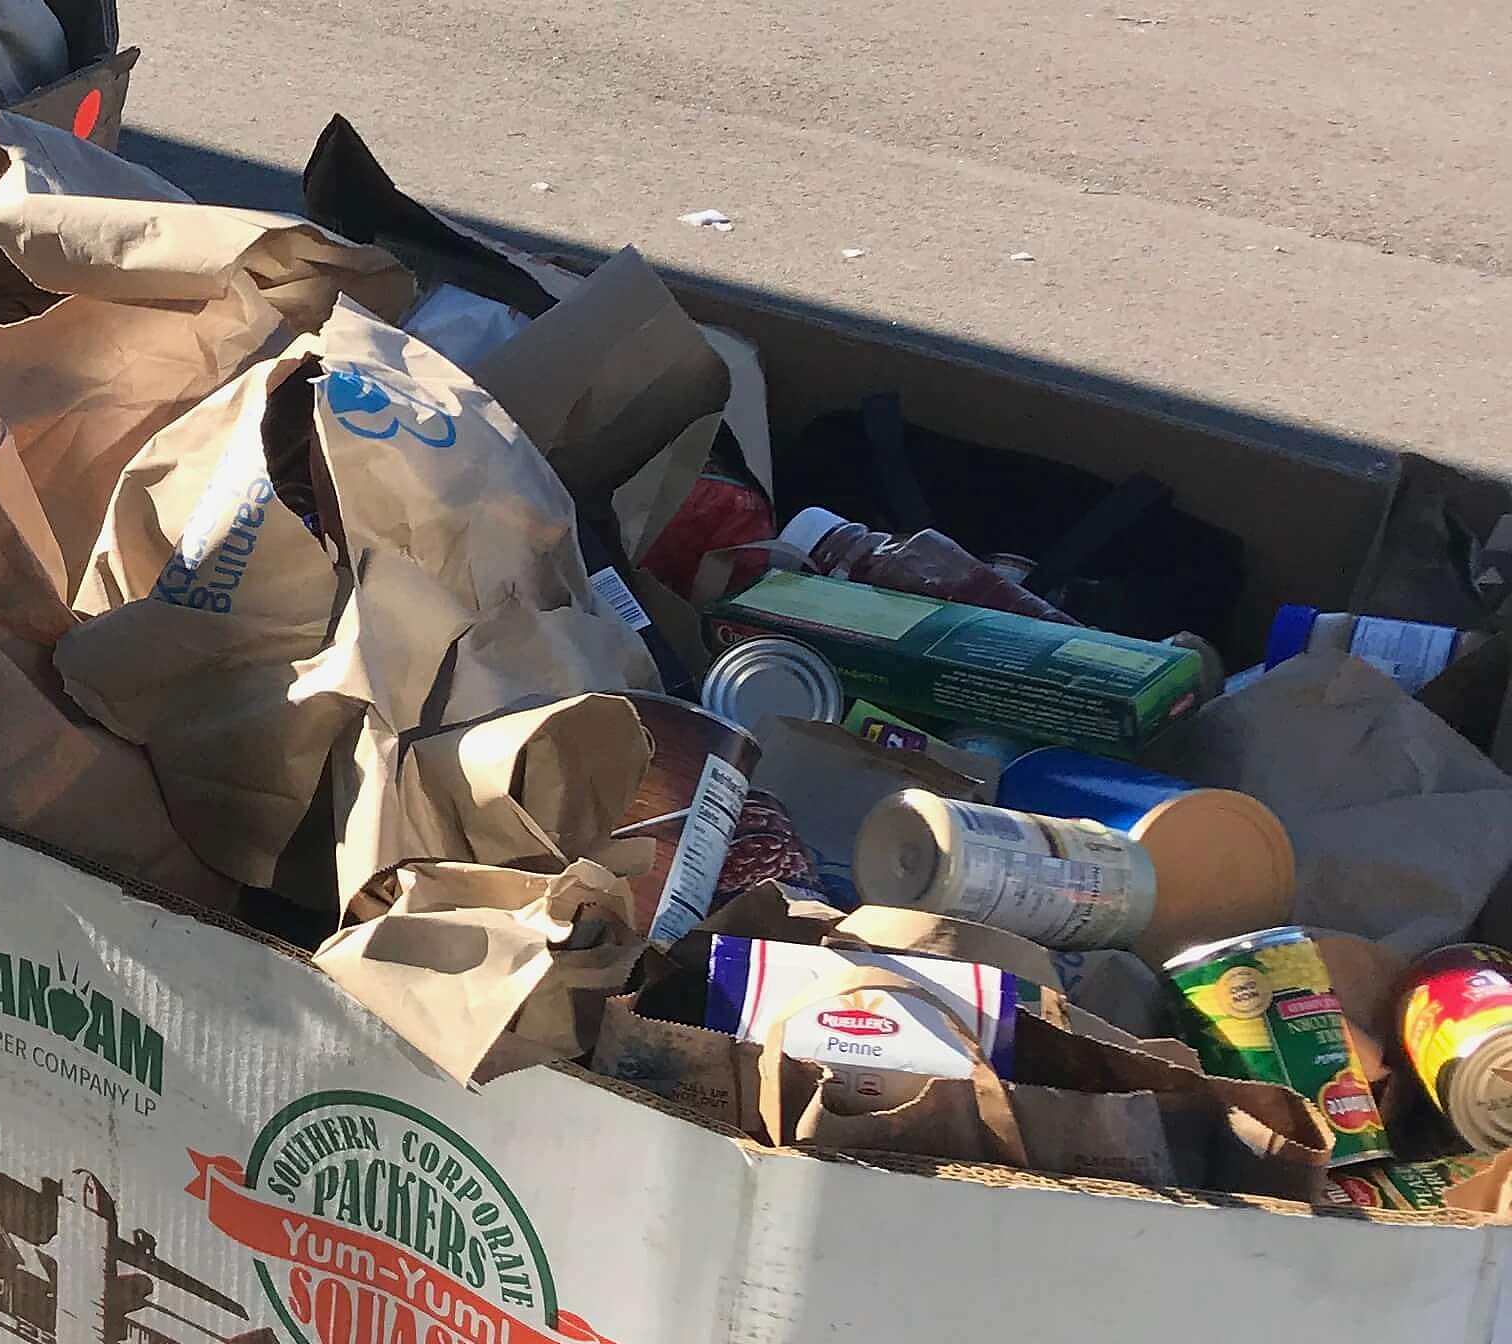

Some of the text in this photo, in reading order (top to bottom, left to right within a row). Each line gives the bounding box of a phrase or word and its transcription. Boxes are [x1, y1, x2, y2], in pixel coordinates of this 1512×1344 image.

[192, 478, 274, 614] eaning
[32, 1046, 130, 1106] COMPANY
[134, 1092, 157, 1117] LP
[827, 1036, 883, 1057] Penne
[267, 1114, 535, 1309] SOUTHERN CORPORATE
[312, 1158, 487, 1290] PACKERS
